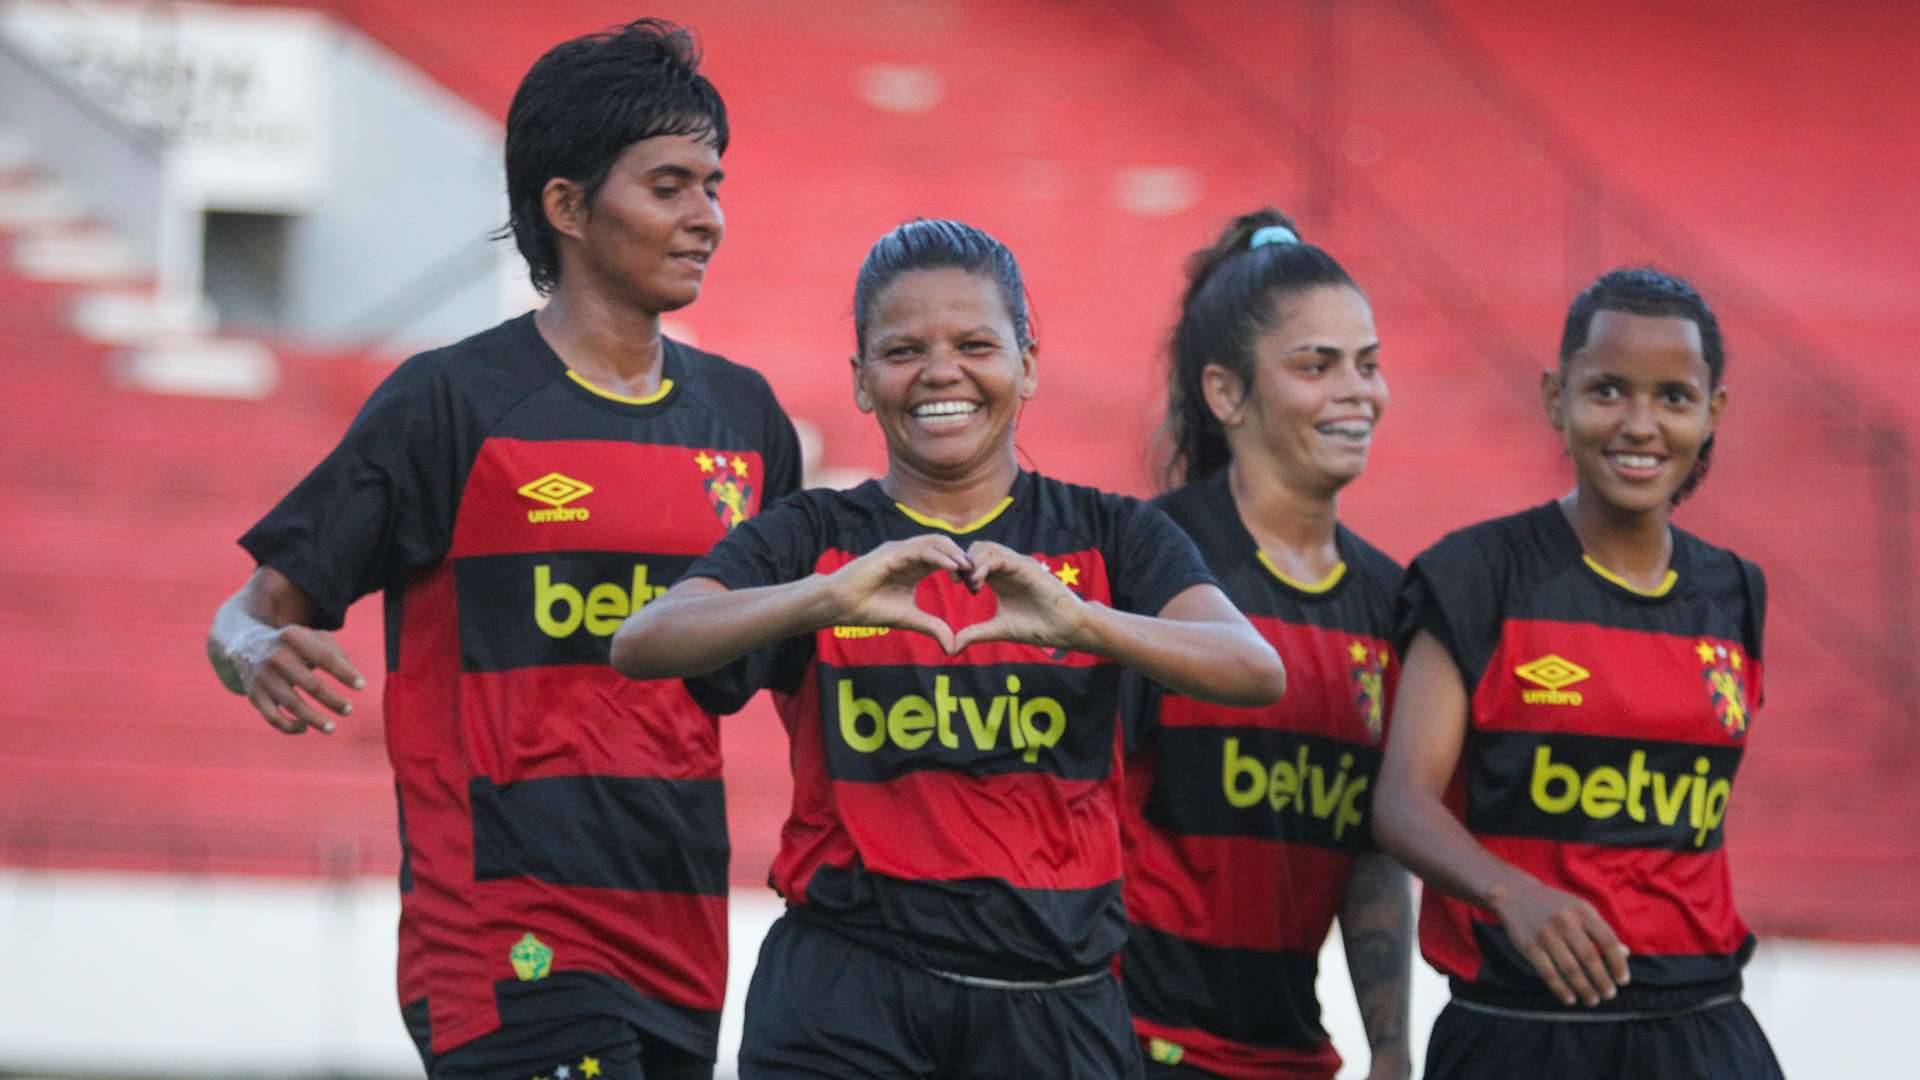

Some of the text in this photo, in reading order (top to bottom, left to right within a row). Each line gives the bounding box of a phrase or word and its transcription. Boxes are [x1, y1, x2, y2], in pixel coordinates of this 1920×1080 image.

[527, 508, 590, 523] umbro
[534, 564, 669, 638] bet
[838, 674, 1067, 763] betvip
[1522, 689, 1583, 707] umbro
[1530, 745, 1731, 847] betvip
